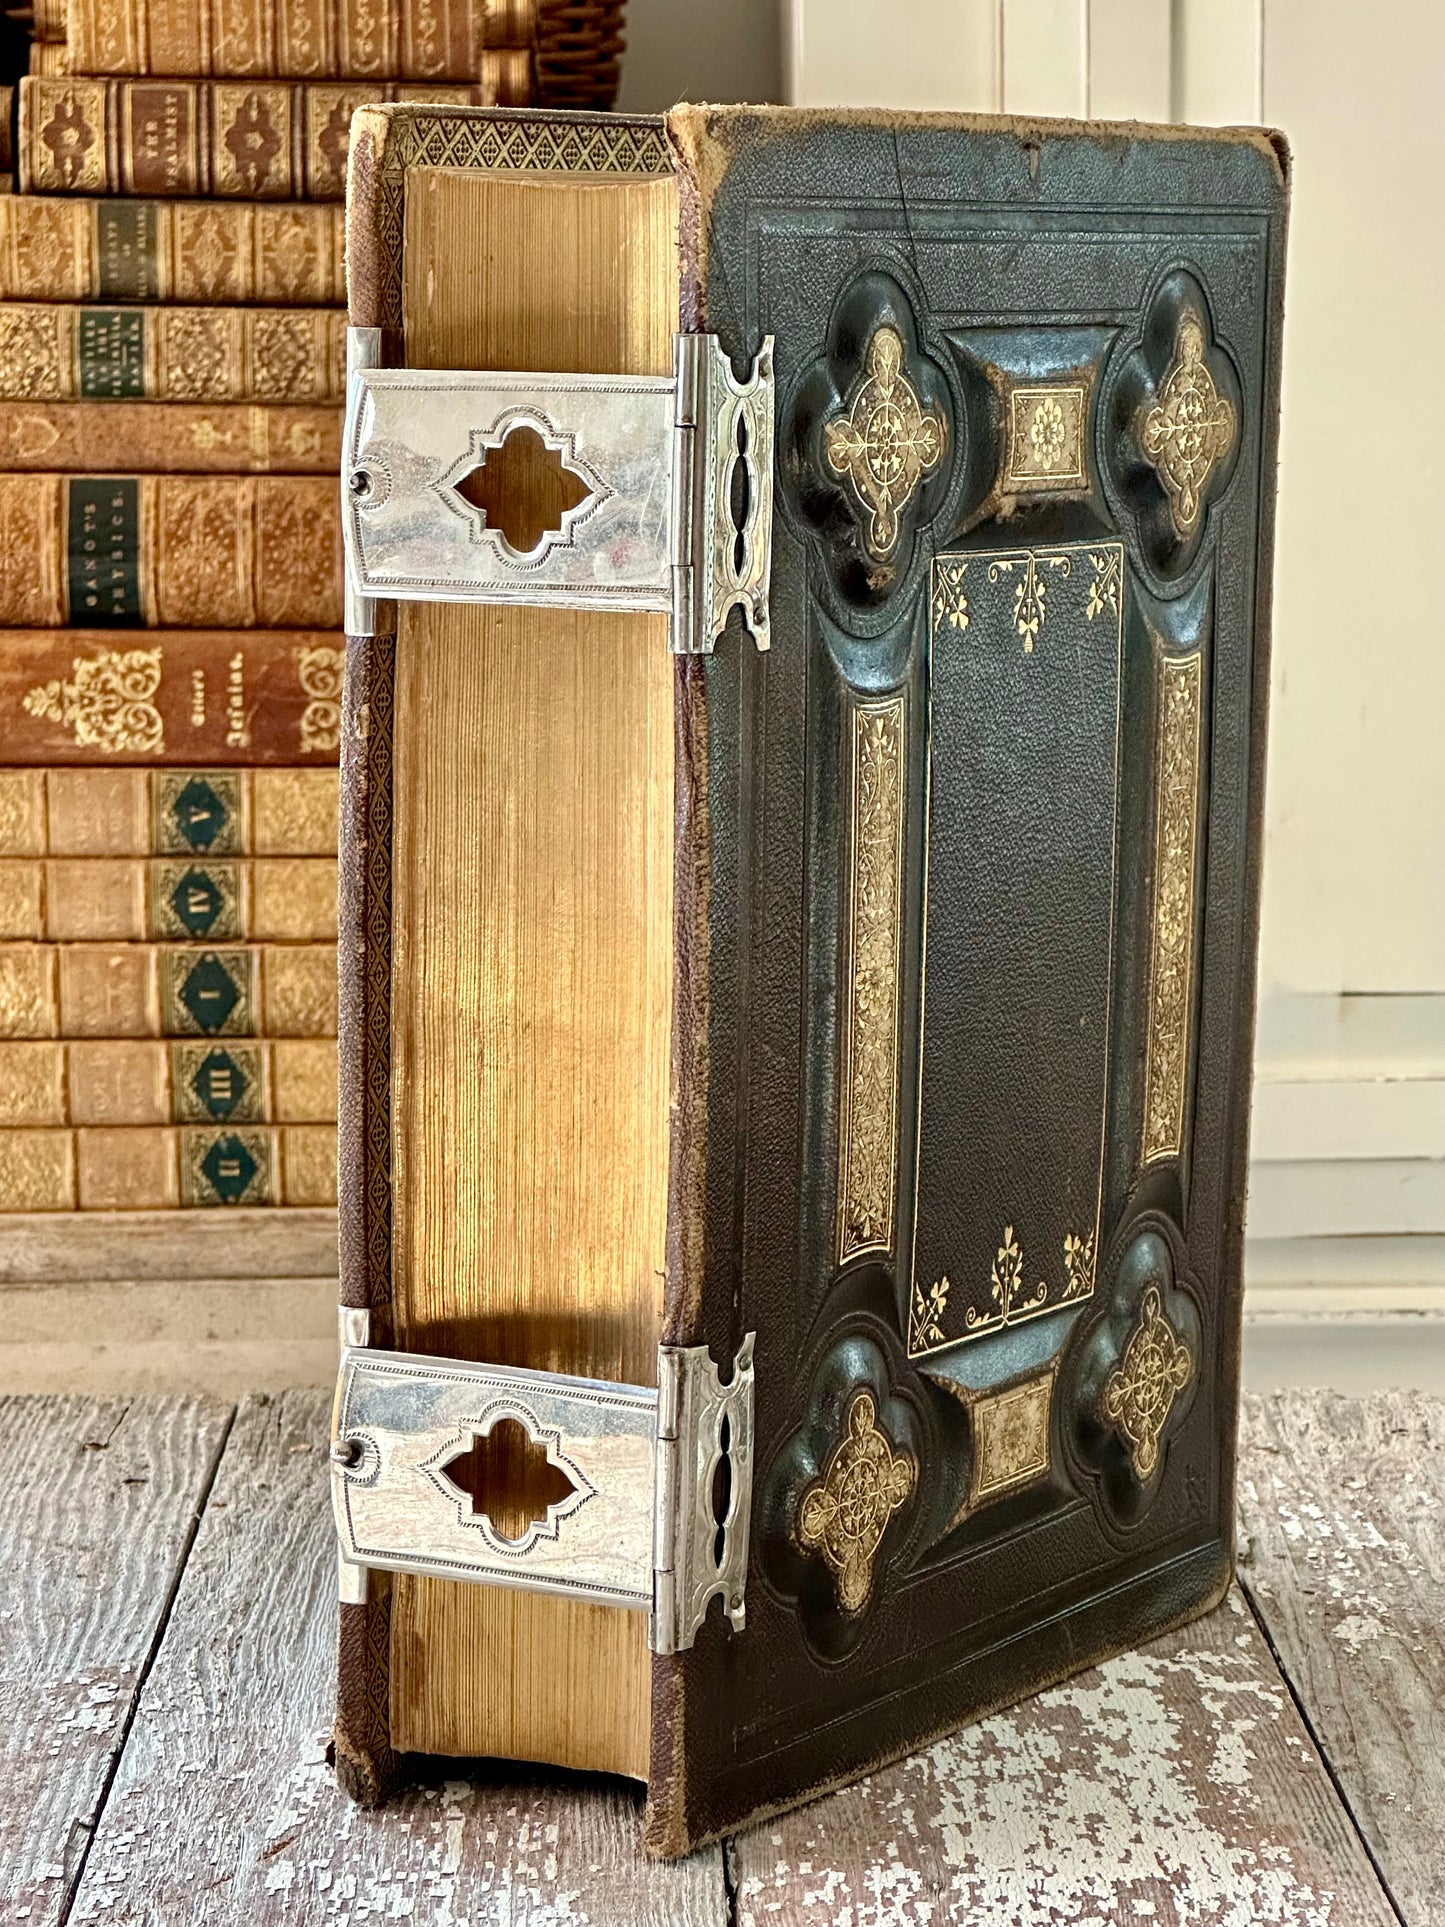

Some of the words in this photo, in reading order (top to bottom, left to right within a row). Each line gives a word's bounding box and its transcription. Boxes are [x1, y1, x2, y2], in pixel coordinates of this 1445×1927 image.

[145, 121, 158, 160] THE
[165, 94, 178, 187] PSALMIST
[83, 502, 98, 607] GANOT'S
[190, 805, 212, 825] V
[187, 886, 212, 914] IV
[199, 989, 221, 999] I
[209, 1068, 232, 1099] III
[218, 1158, 240, 1178] II
